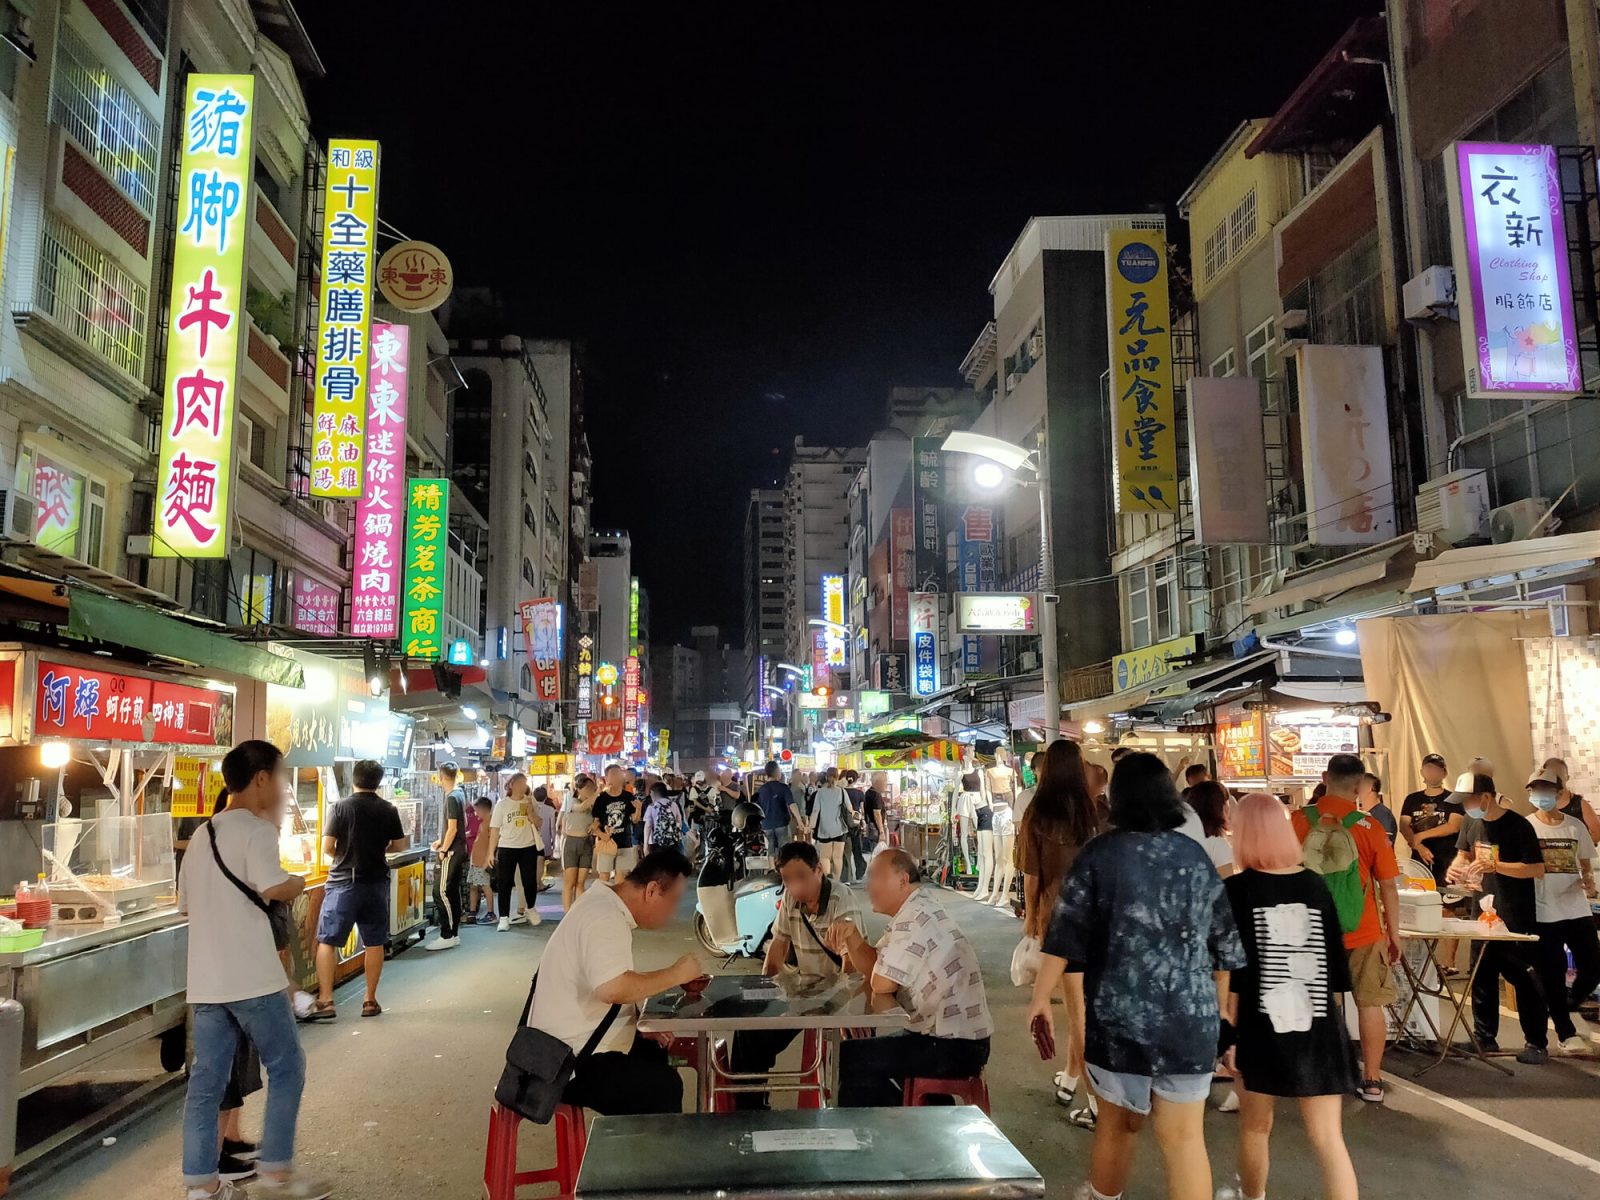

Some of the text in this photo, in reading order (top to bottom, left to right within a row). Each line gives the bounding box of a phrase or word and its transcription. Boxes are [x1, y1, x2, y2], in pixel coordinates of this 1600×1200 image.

[323, 175, 370, 400] 十全藥膳排骨
[1489, 257, 1539, 271] Clothing
[1520, 271, 1549, 283] Shop
[1496, 293, 1552, 311] 服飾店
[1119, 291, 1165, 460] 元品食堂
[314, 414, 337, 490] 鮮魚湯
[337, 414, 361, 489] 麻油雞
[361, 329, 407, 593] 東東迷你火鍋燒肉
[408, 484, 443, 662] 精芳茗茶商行
[42, 670, 99, 731] 阿輝
[105, 696, 144, 725] 蚵仔煎
[152, 701, 185, 729] 四神湯
